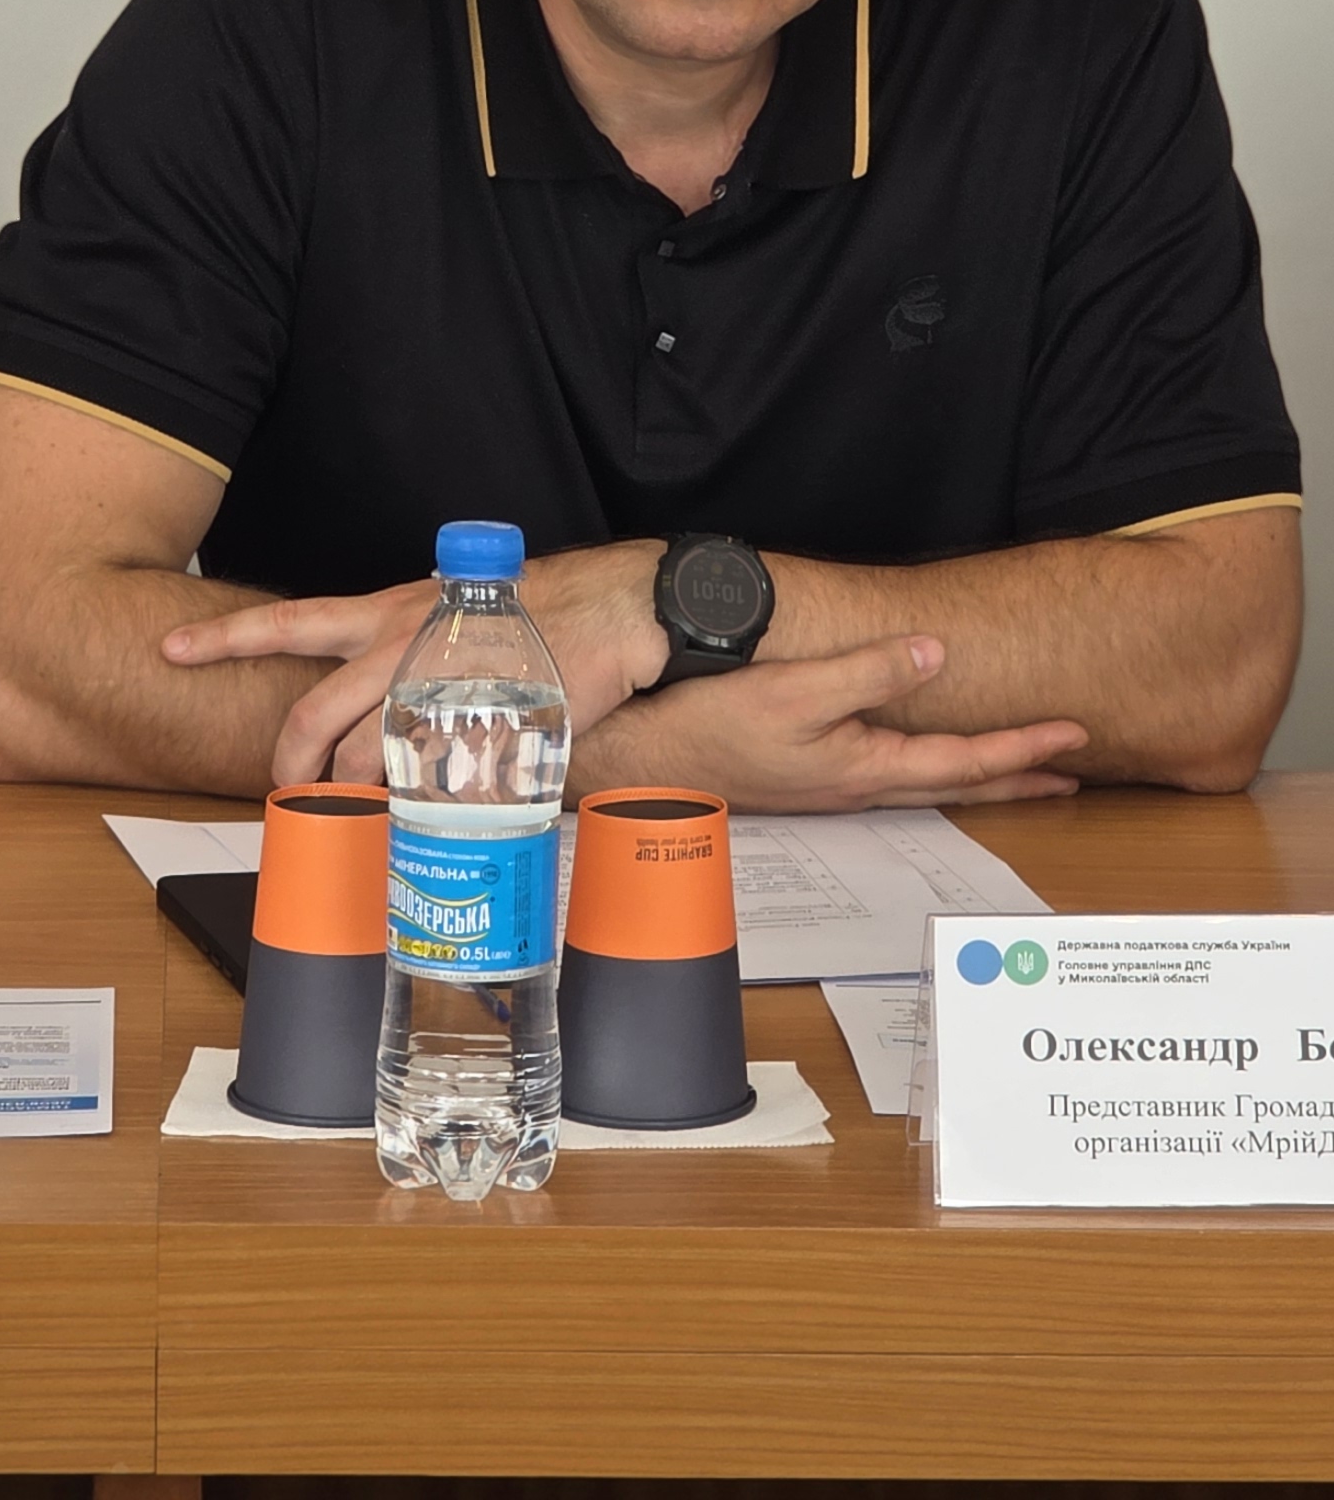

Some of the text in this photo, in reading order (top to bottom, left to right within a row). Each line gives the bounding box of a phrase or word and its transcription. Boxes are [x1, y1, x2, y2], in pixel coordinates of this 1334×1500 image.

[692, 579, 745, 605] 10:01
[636, 843, 712, 862] GRAPHITE CUP
[395, 857, 468, 881] МІНЕРАЛЬНА
[1057, 940, 1291, 953] Державна податкова служба України
[1058, 960, 1212, 973] Головне управління ДПС
[1068, 973, 1160, 984] Миколаївській
[1163, 973, 1210, 984] області
[1022, 1028, 1259, 1072] Олександр
[1048, 1094, 1226, 1124] Представник
[1074, 1129, 1223, 1160] організації
